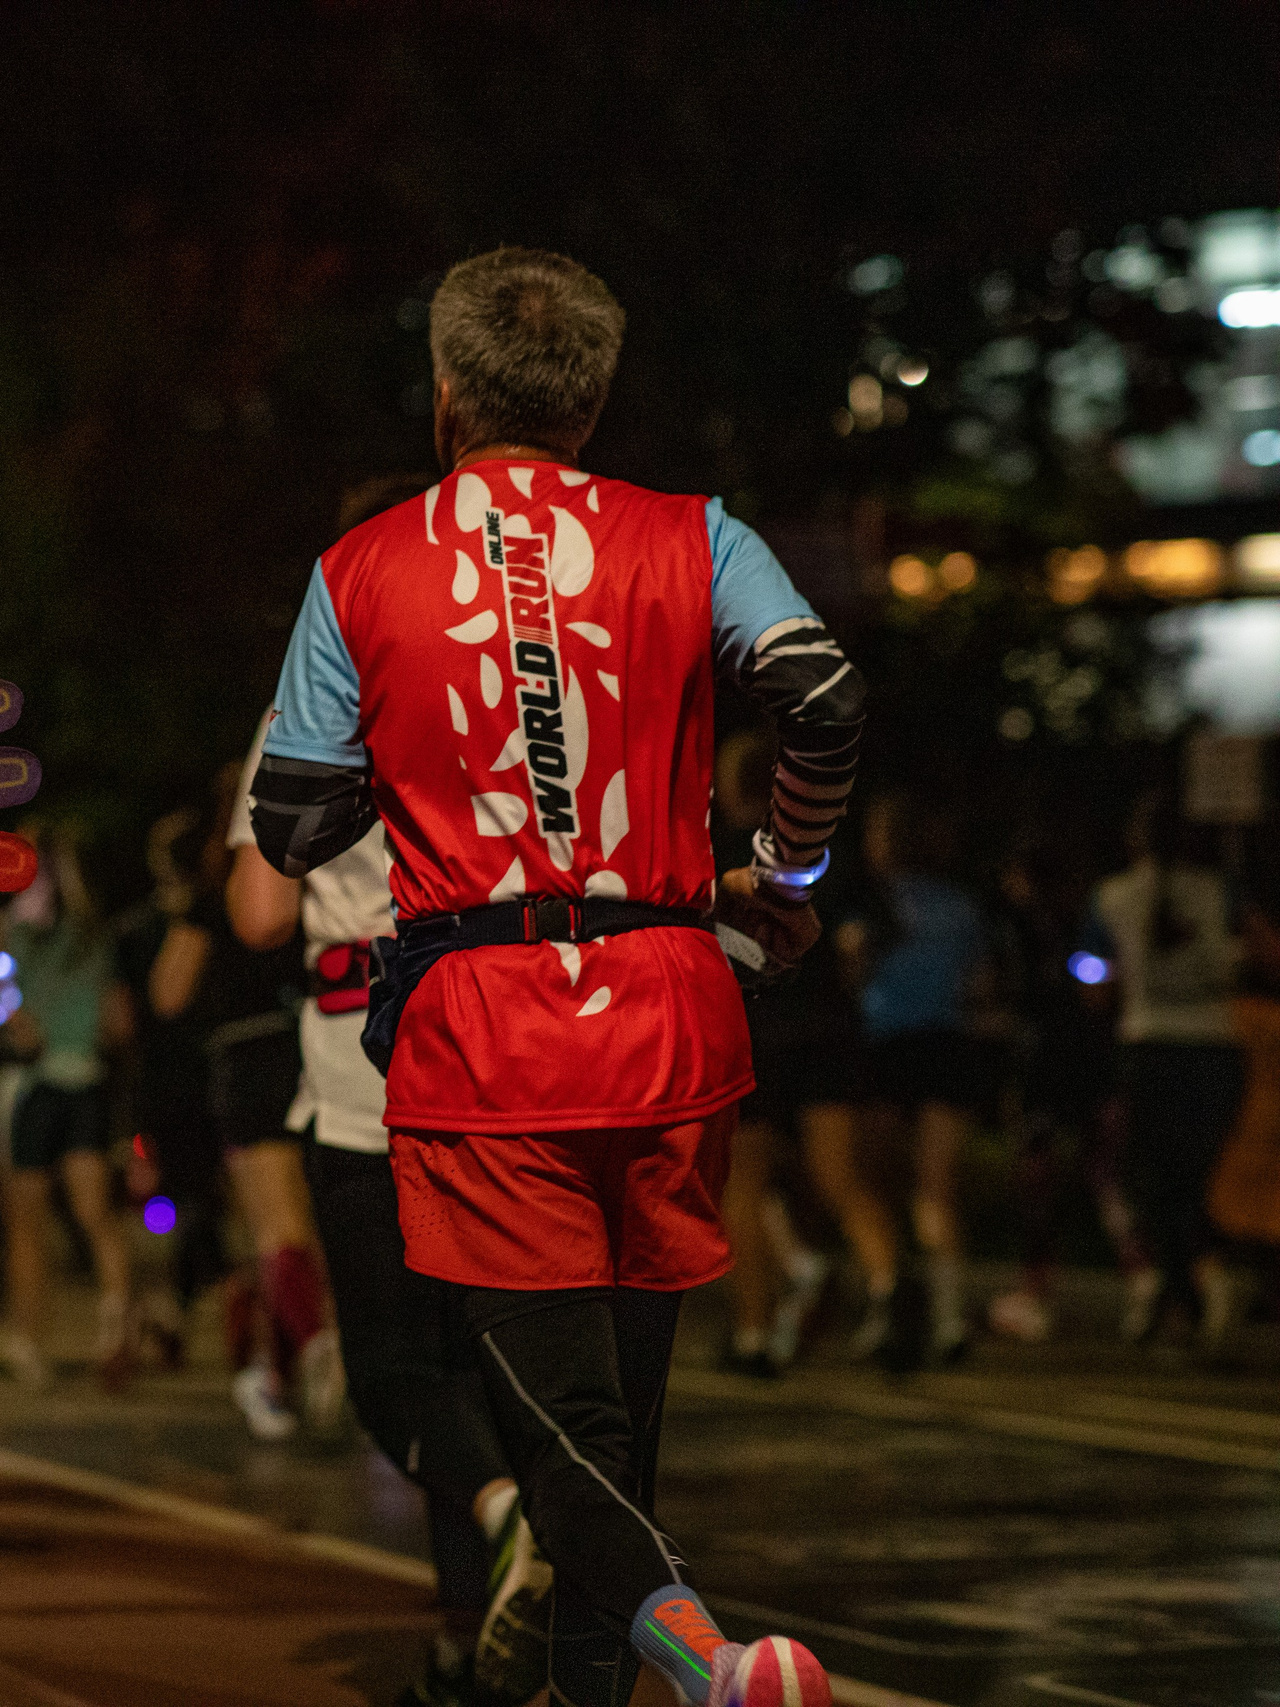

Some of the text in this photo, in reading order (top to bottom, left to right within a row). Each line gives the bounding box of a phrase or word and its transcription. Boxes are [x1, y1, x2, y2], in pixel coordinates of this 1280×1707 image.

[485, 510, 505, 566] ONLINE
[503, 535, 576, 833] WORLD RUN
